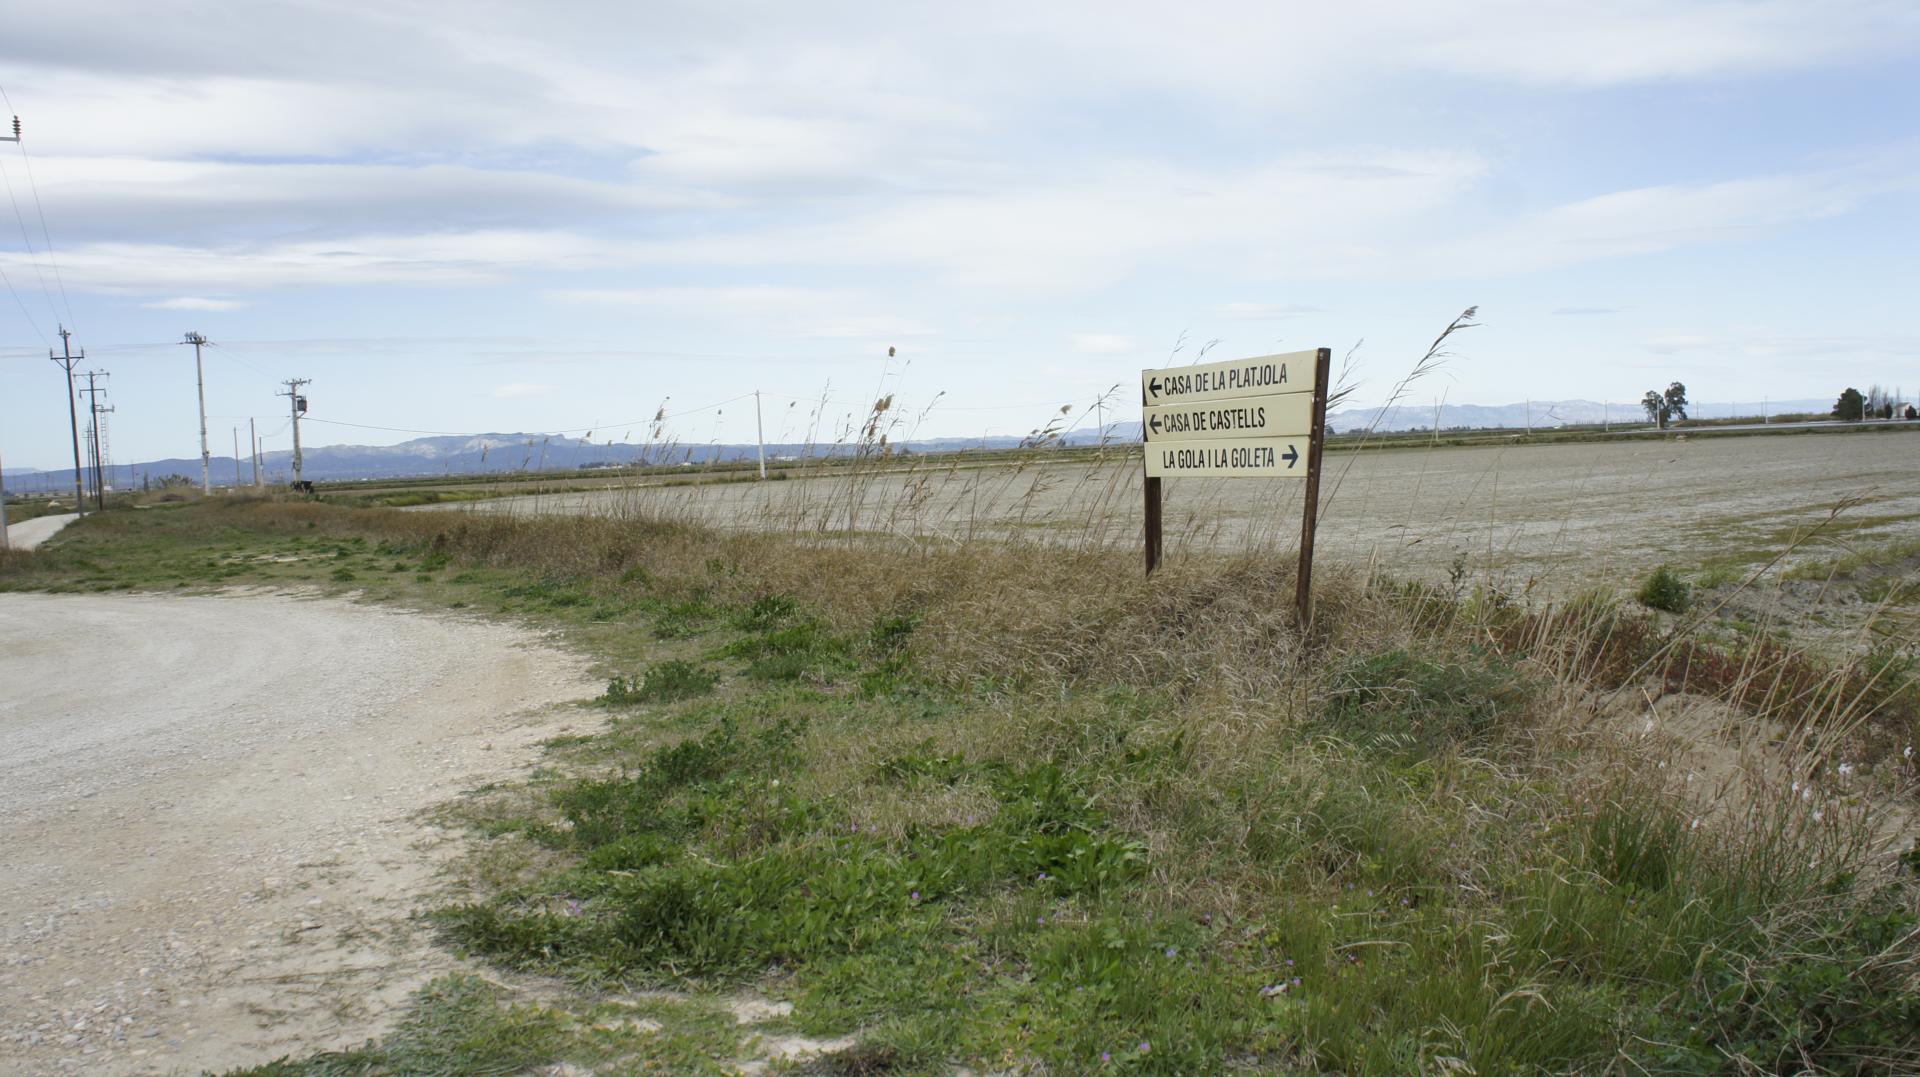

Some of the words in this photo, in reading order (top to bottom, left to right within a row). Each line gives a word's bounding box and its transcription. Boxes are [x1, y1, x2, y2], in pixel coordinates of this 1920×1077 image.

[1164, 375, 1192, 395] CASA
[1195, 372, 1208, 392] DE
[1212, 371, 1225, 391] LA
[1230, 363, 1287, 389] PLATJOLA
[1163, 412, 1191, 432] CASA
[1193, 411, 1206, 431] DE
[1210, 407, 1265, 430] CASTELLS
[1163, 451, 1175, 468] LA
[1178, 449, 1205, 468] GOLA
[1208, 449, 1211, 468] I
[1214, 449, 1228, 468] LA
[1232, 447, 1274, 468] GOLETA
